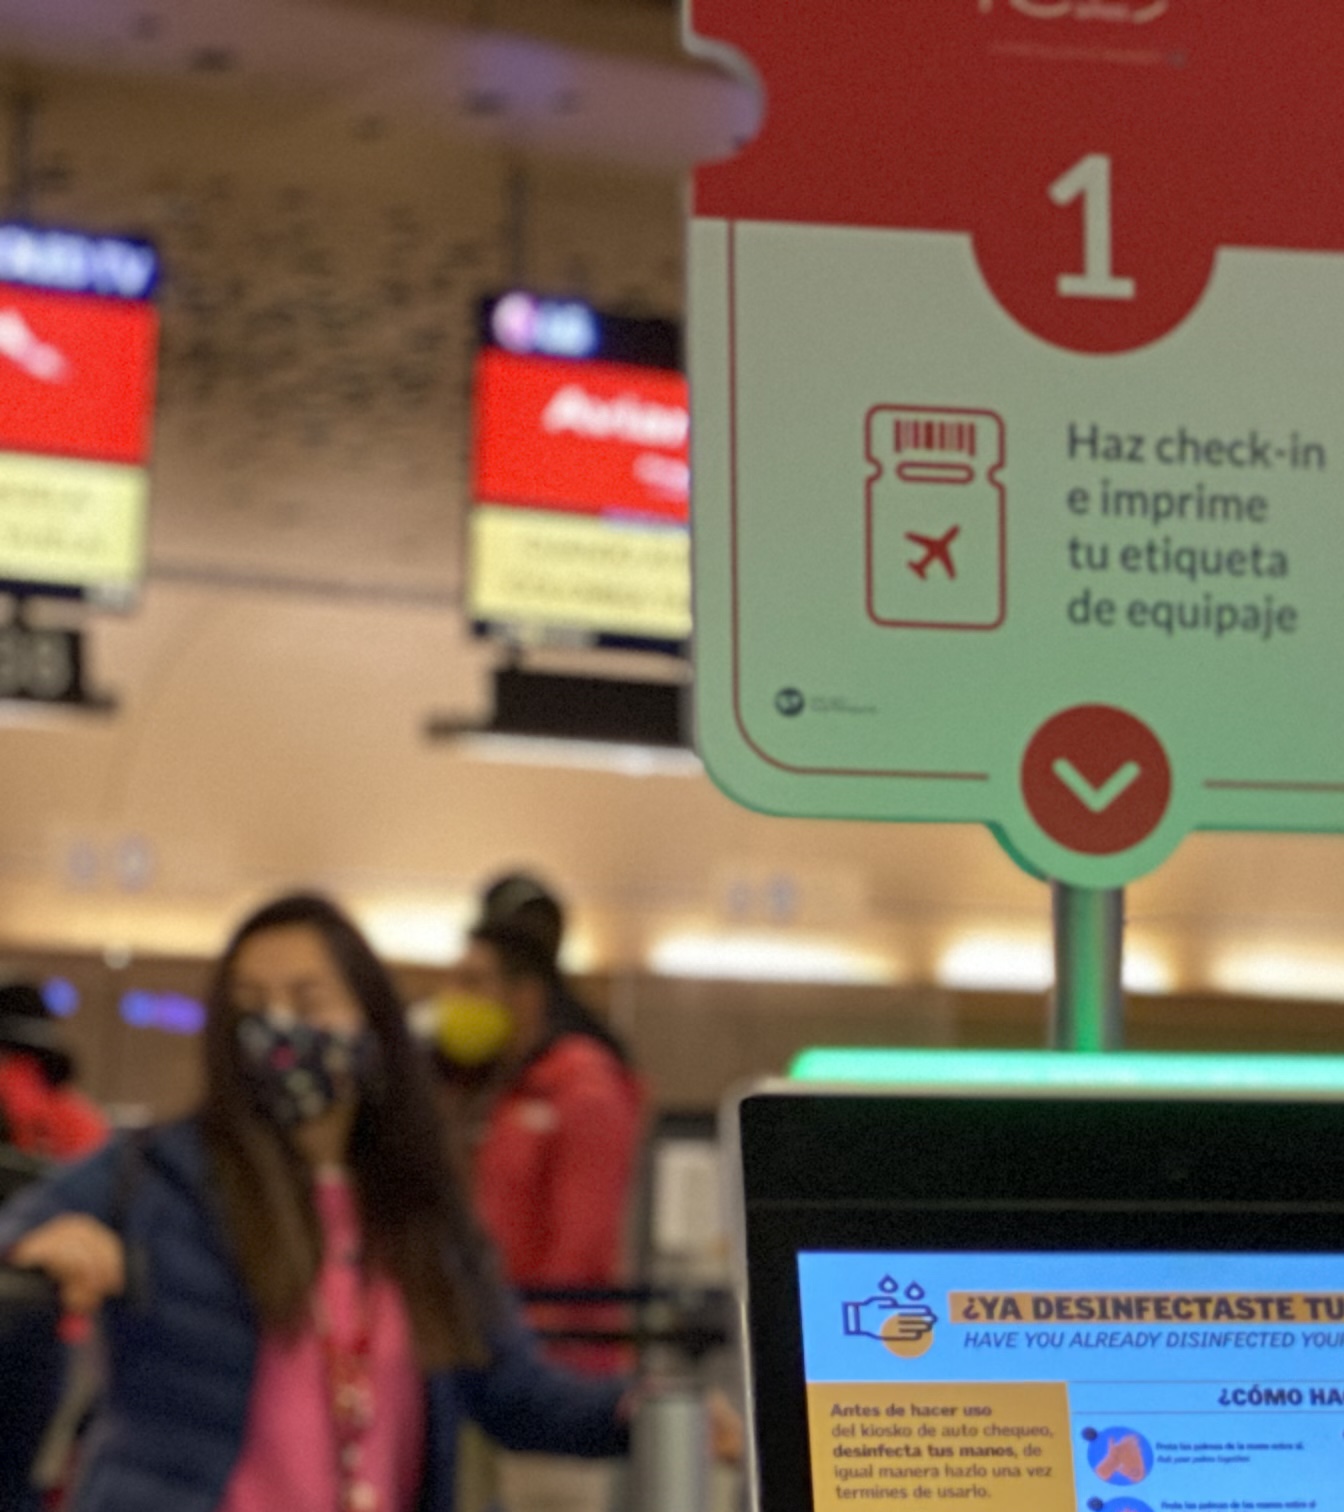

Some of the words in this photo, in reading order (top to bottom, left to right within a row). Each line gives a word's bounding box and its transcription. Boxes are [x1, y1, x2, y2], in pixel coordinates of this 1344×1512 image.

[1048, 152, 1135, 301] 1
[1068, 421, 1145, 463] Haz
[1155, 425, 1327, 471] check-in
[1067, 485, 1090, 516] e
[1101, 478, 1269, 527] imprime
[1068, 536, 1109, 571] tu
[1120, 535, 1289, 583] etiqueta
[1067, 587, 1116, 627] de
[1127, 591, 1298, 641] equipaje
[961, 1294, 1022, 1322] ¿YA
[1031, 1294, 1296, 1321] DESINFECTASTE
[963, 1331, 1018, 1349] HAVE
[1024, 1331, 1065, 1349] YOU
[1069, 1331, 1160, 1349] ALREADY
[1164, 1331, 1296, 1349] DISINFECTED
[1217, 1383, 1302, 1407] ¿CÓMO
[830, 1404, 880, 1418] Antes
[885, 1403, 905, 1417] de
[910, 1403, 957, 1417] hacer
[963, 1405, 992, 1417] uso
[831, 1424, 856, 1437] del
[860, 1424, 912, 1437] kiosko
[917, 1424, 937, 1437] de
[941, 1424, 979, 1437] auto
[983, 1423, 1054, 1439] chequeo,
[832, 1444, 921, 1458] desinfecta
[927, 1445, 954, 1457] tus
[959, 1445, 1018, 1459] manos,
[1022, 1445, 1042, 1457] de
